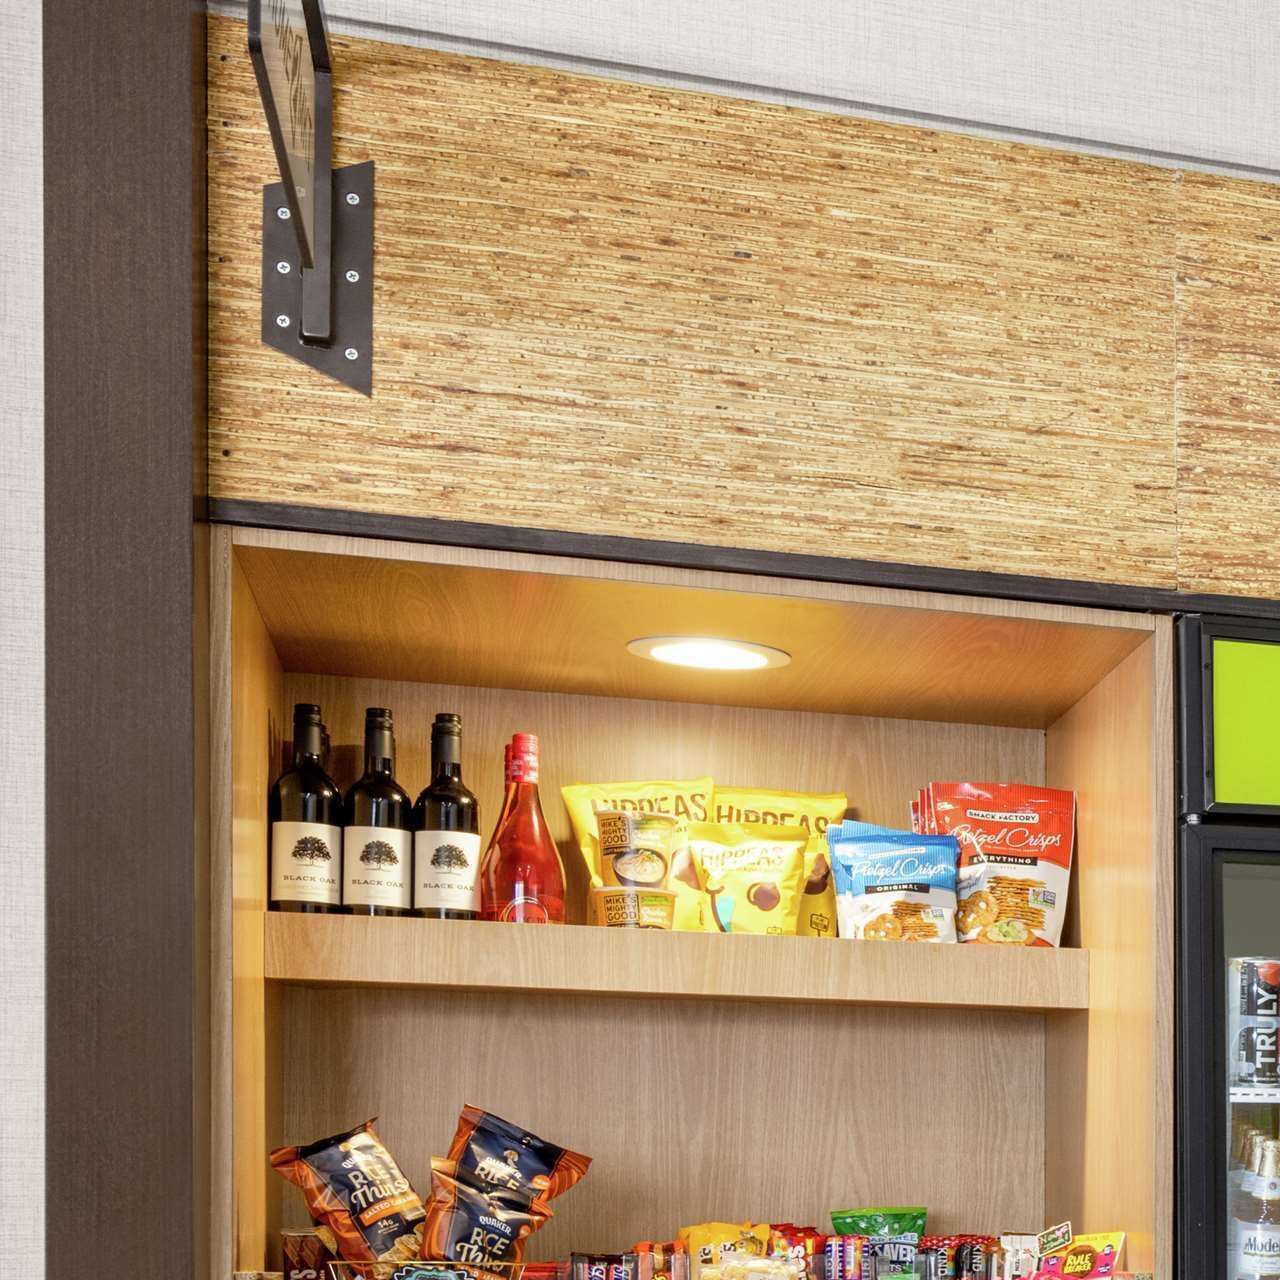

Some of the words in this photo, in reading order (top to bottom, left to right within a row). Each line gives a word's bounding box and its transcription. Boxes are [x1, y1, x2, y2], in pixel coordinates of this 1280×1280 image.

[602, 834, 627, 845] GOOD
[1006, 828, 1061, 852] Crisps
[900, 856, 947, 875] Crisps
[283, 874, 315, 883] BLACK
[317, 877, 337, 886] OAK
[351, 879, 381, 887] BLACK
[383, 880, 405, 889] OAK
[423, 882, 452, 890] BLACK
[606, 904, 637, 912] MIGHTY
[607, 911, 636, 921] GOOD
[1255, 986, 1278, 1069] TRULY
[351, 1178, 409, 1208] Thins
[480, 1215, 512, 1235] QUAKER
[470, 1227, 510, 1255] RICE
[937, 1247, 948, 1276] KIND
[971, 1244, 982, 1272] KIND
[1067, 1253, 1091, 1264] RULE
